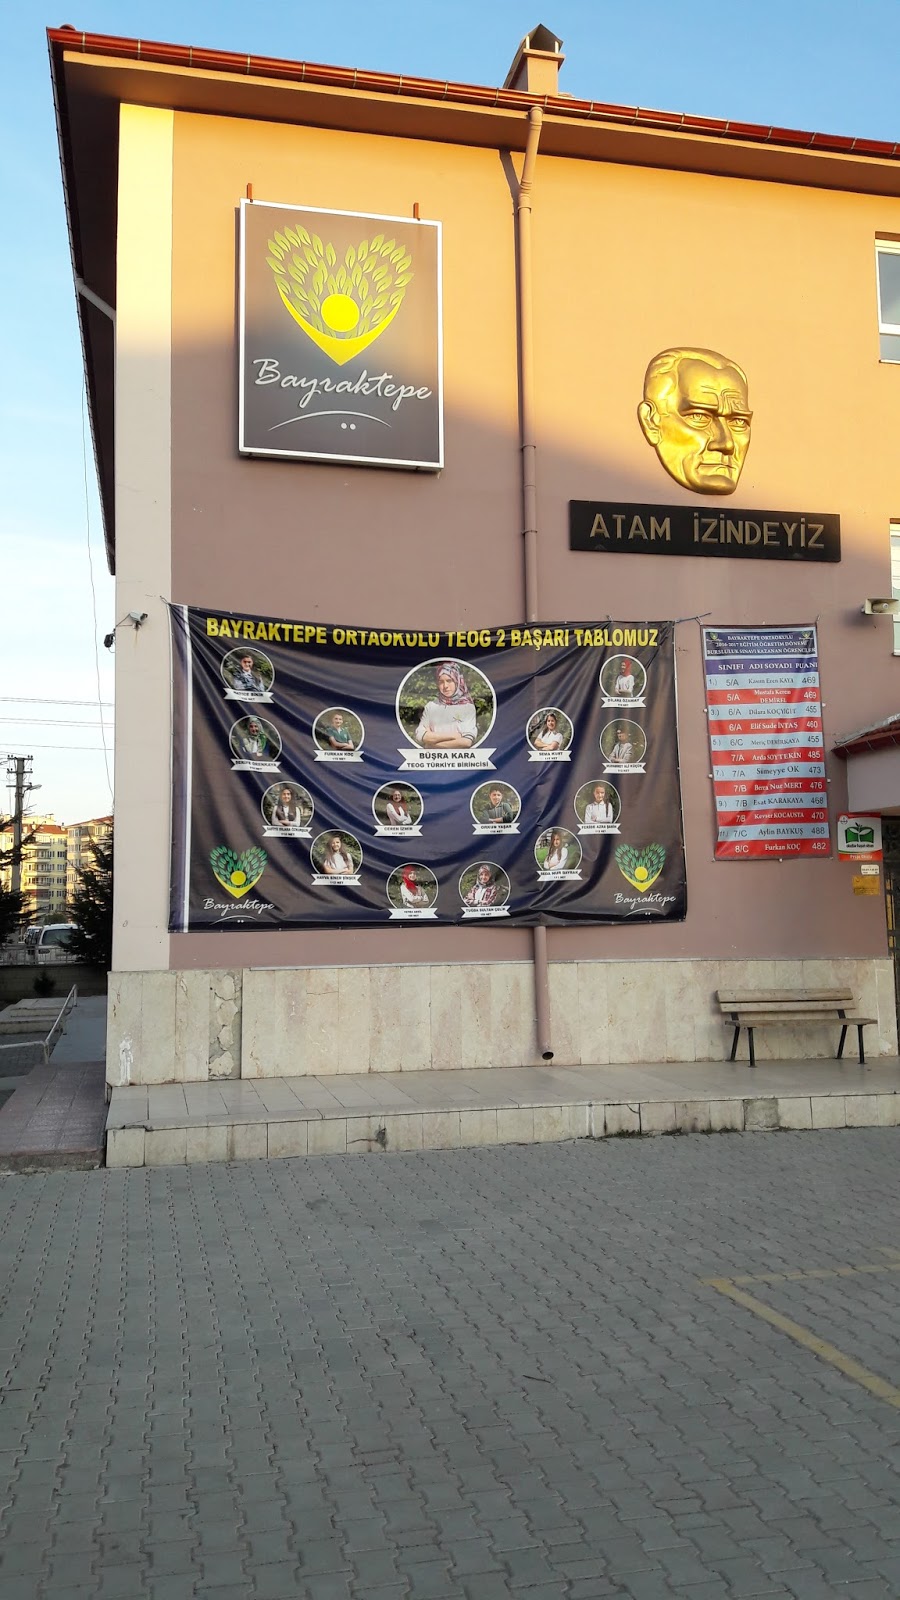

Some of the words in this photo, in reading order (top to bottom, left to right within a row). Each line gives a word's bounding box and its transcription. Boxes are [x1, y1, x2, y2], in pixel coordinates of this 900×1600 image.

[253, 358, 432, 411] Bayraktepe
[590, 513, 671, 541] ATAM
[694, 512, 825, 549] İZİNDEYİZ
[206, 617, 327, 644] BAYRAKTEPE
[332, 628, 440, 648] ORTAOKULU
[447, 631, 491, 647] TEOG
[495, 629, 506, 647] 2
[510, 628, 569, 650] BAŞARI
[573, 628, 658, 647] TABLOMUZ
[419, 752, 449, 760] BÜŞRA
[776, 828, 803, 836] BAYKUŞ
[812, 842, 826, 850] 482
[203, 898, 275, 916] Bayraktepe
[614, 893, 676, 909] Bayraktepe
